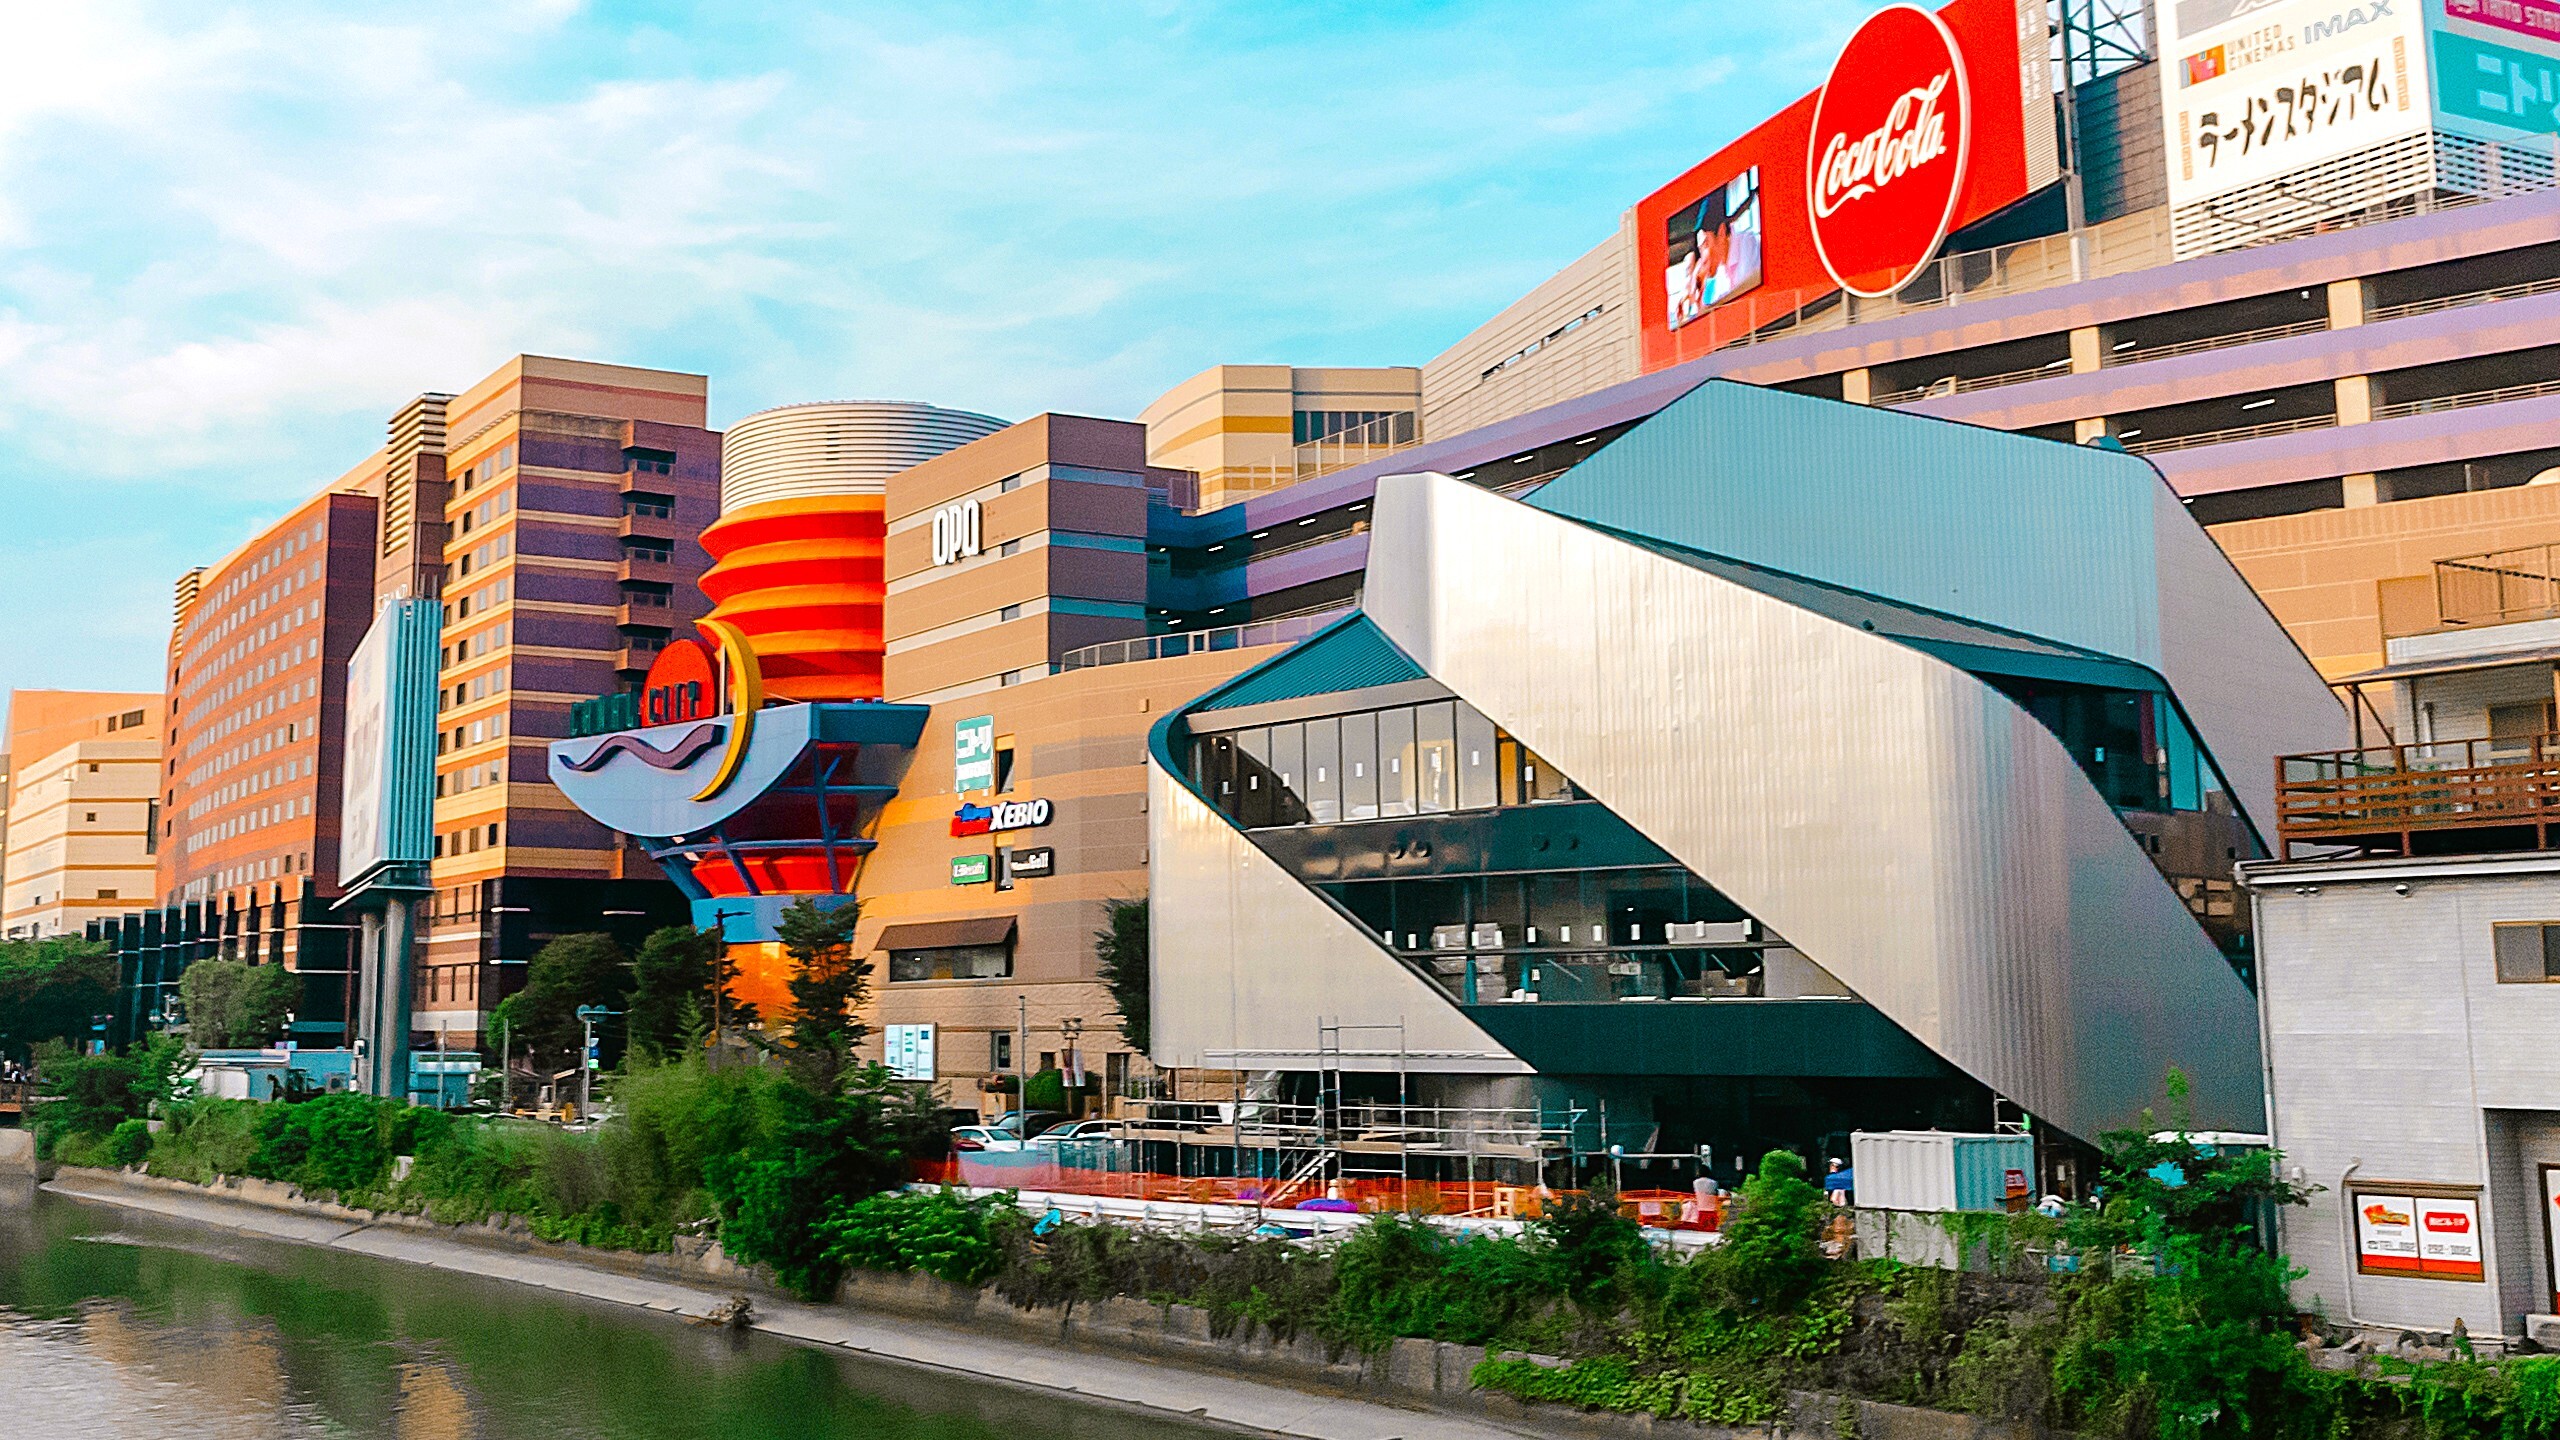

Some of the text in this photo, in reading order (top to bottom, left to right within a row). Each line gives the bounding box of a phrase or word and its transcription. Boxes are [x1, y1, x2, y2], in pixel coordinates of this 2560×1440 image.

[2227, 24, 2282, 55] UNITED
[2304, 0, 2393, 44] IMAX
[2229, 36, 2295, 71] CINEMAS
[2199, 58, 2388, 168] ラーメンスタジアム
[1814, 68, 1952, 218] Coca-Cola
[648, 681, 702, 724] CITY
[989, 799, 1049, 831] XEBIO
